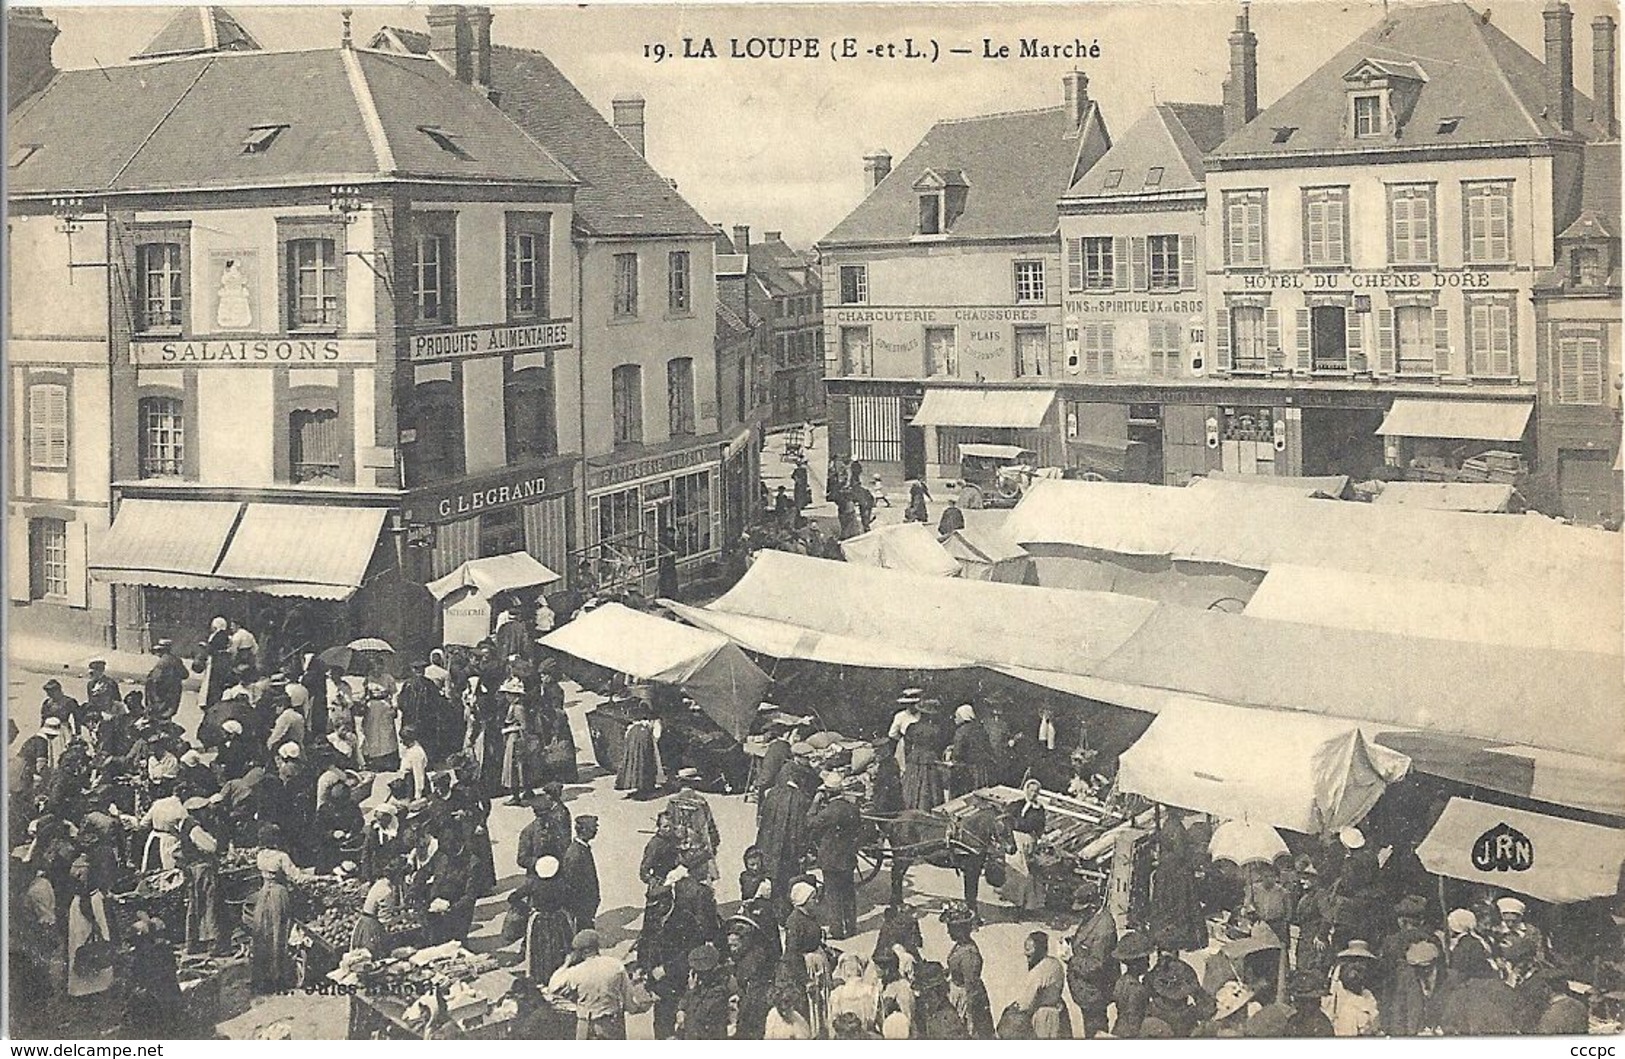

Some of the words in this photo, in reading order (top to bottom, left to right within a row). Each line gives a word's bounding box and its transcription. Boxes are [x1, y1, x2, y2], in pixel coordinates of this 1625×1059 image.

[1314, 274, 1339, 288] DU
[1352, 273, 1421, 288] CHENE
[1432, 272, 1489, 288] DORE
[837, 310, 937, 322] CHARCUTERIE
[955, 308, 1038, 321] CHAUSSURES
[1065, 300, 1090, 313] VINS
[1099, 300, 1164, 314] SPIRITUEUX
[1173, 300, 1204, 314] GROS
[415, 332, 479, 358] PRODUITS
[487, 325, 567, 351] ALIMENTAIRES
[161, 341, 340, 362] SALAISONS
[457, 477, 546, 513] LEGRAND
[1476, 833, 1531, 866] JRN
